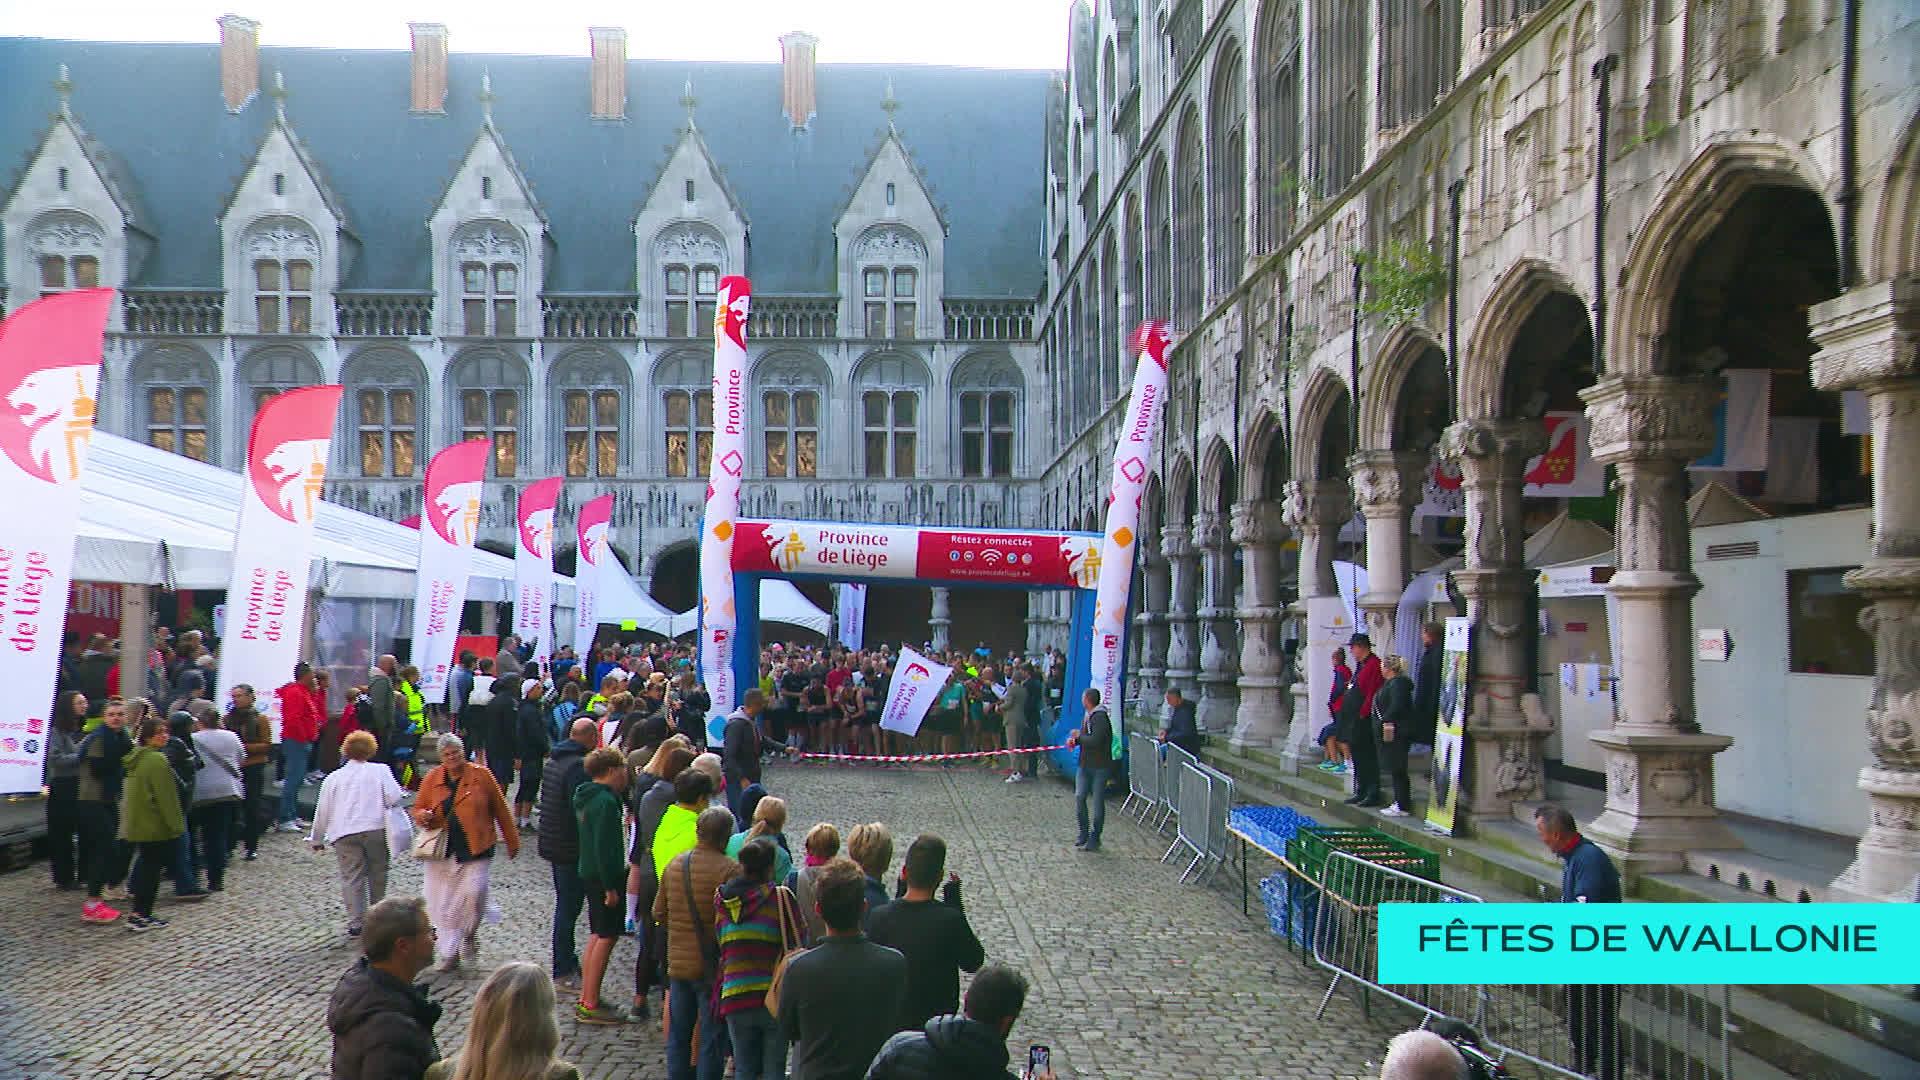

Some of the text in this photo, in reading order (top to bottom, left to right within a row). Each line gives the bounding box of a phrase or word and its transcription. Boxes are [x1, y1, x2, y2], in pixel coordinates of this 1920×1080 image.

[725, 369, 741, 435] Province
[1129, 384, 1157, 441] Province
[817, 547, 888, 571] de Liège
[818, 530, 889, 546] Province
[951, 535, 1033, 547] Restez connectés
[8, 551, 54, 652] de Liège
[240, 568, 266, 640] Province
[263, 570, 295, 641] de Liège
